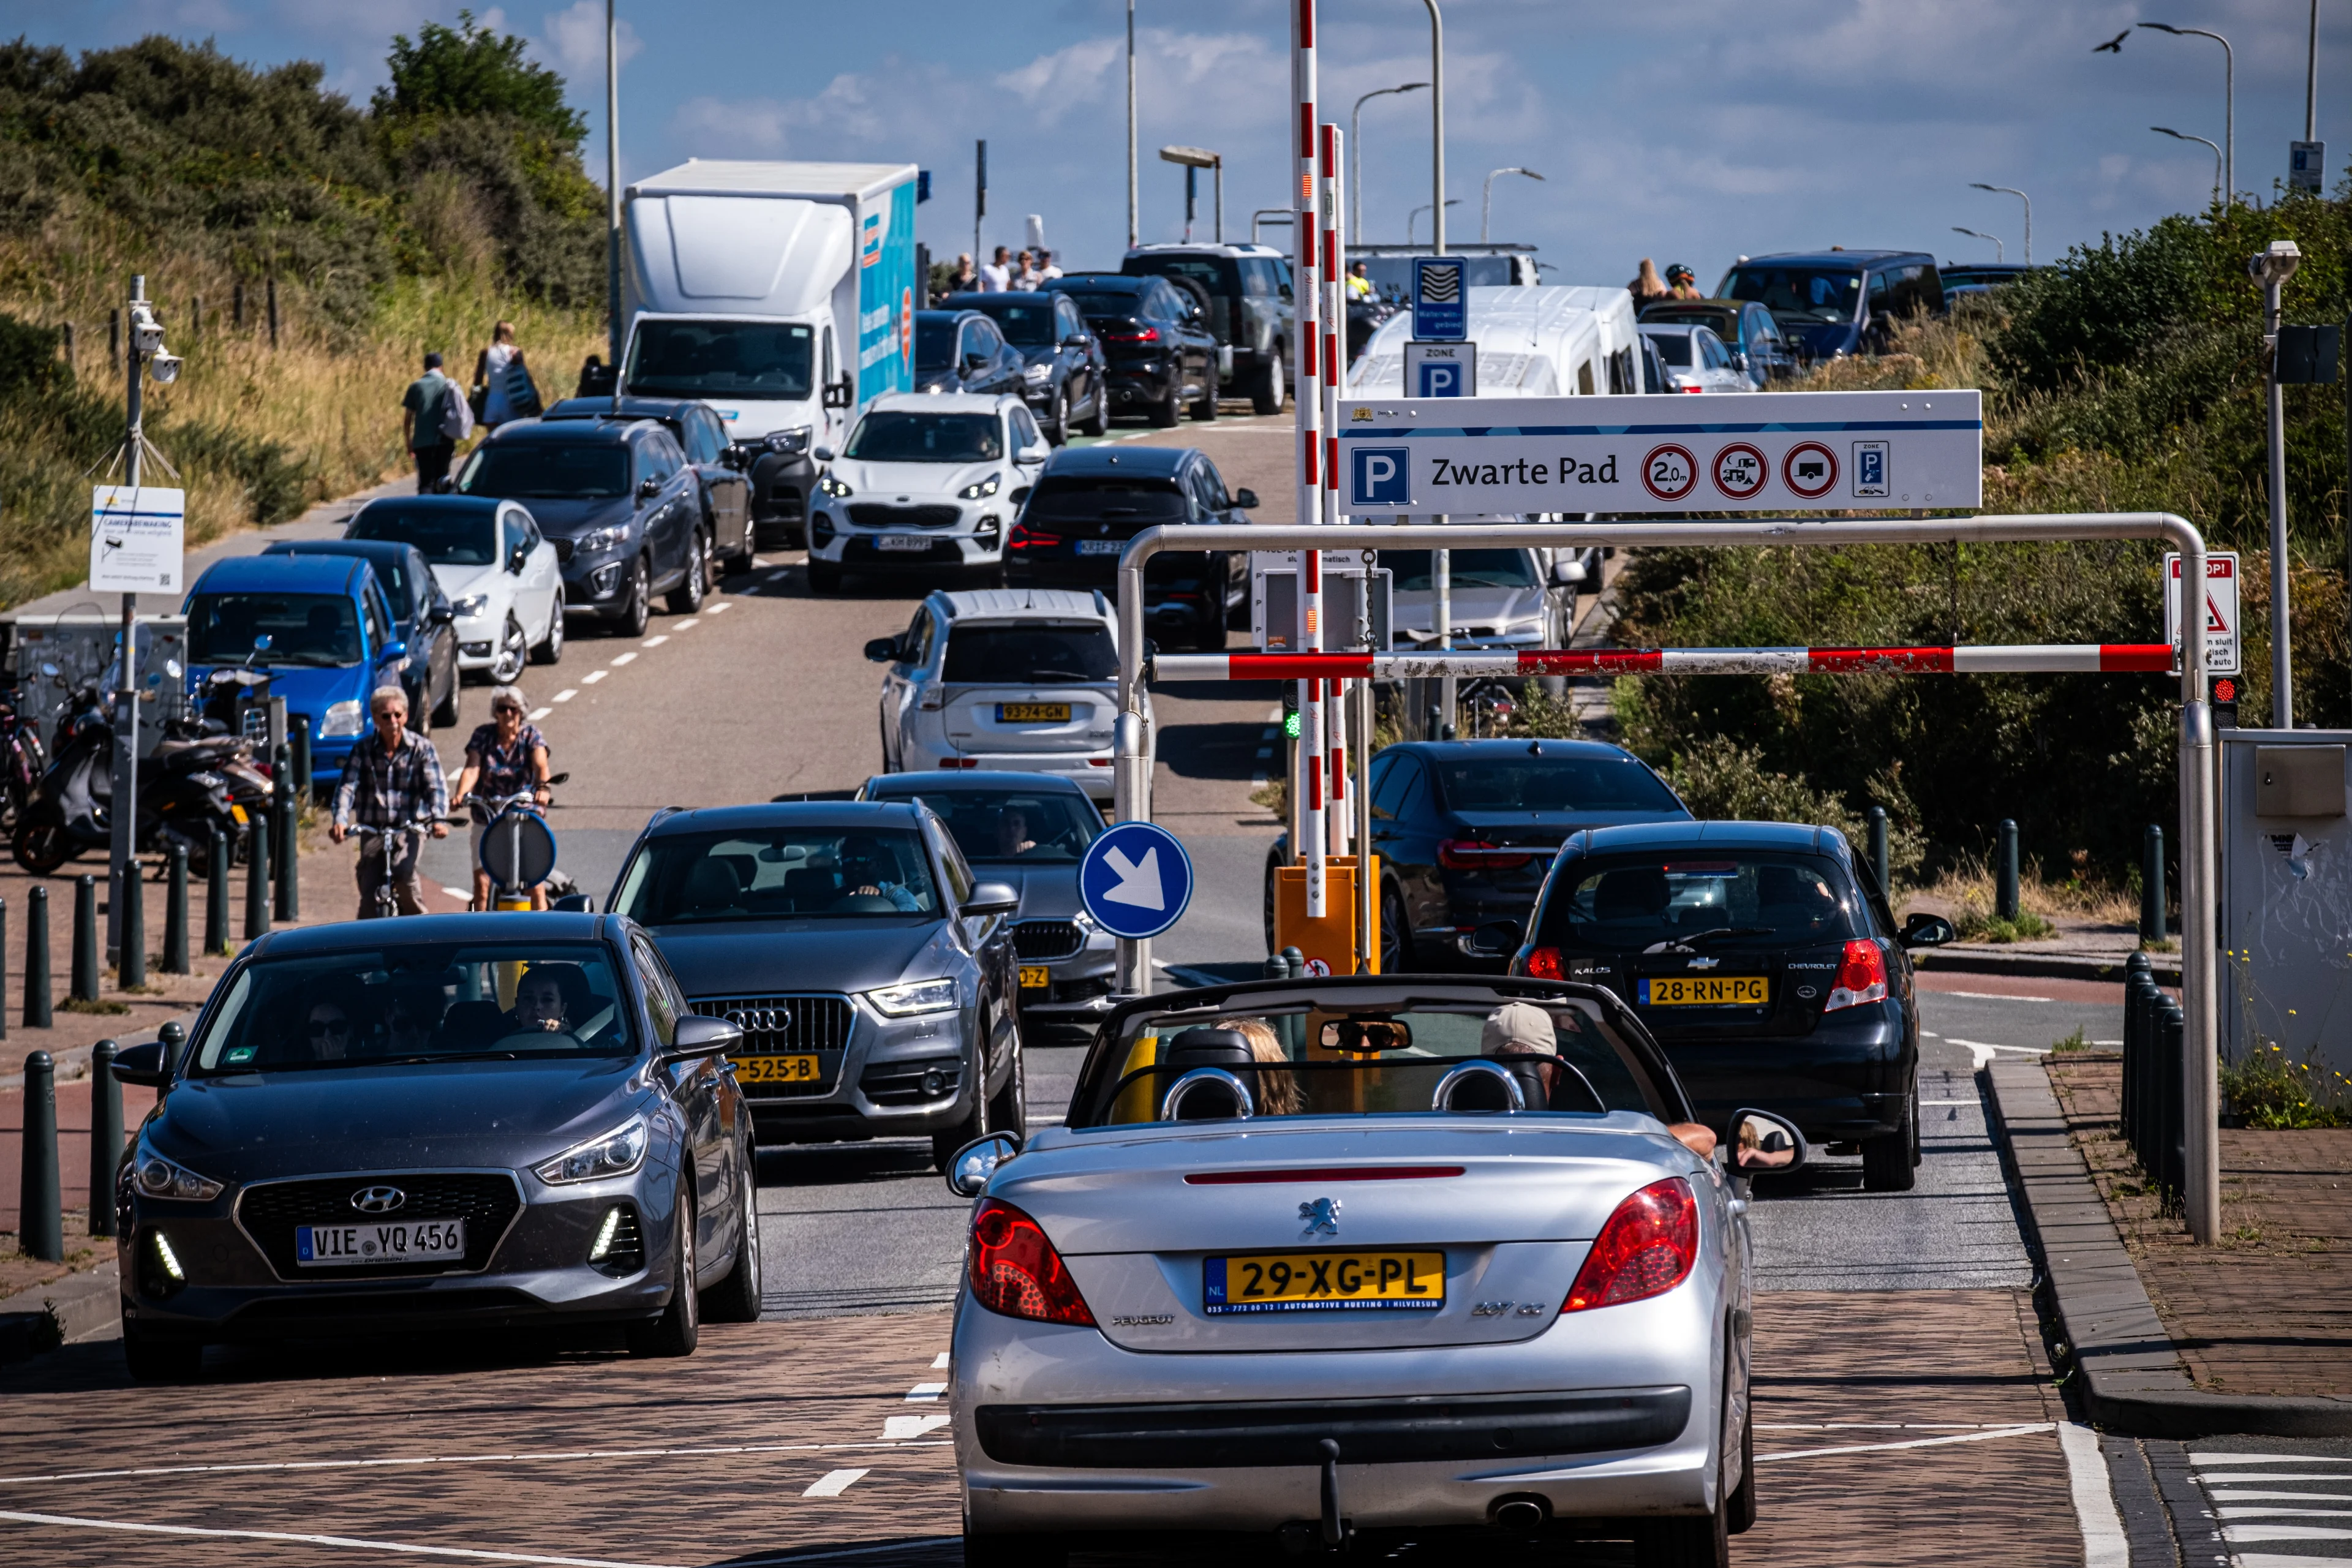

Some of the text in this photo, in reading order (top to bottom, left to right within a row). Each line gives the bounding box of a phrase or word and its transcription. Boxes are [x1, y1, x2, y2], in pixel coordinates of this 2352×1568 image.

[1434, 321, 1463, 330] gebied
[1425, 349, 1455, 358] ZONE
[1432, 454, 1619, 485] Zwarte Pad
[1866, 454, 1878, 470] P
[1366, 455, 1396, 497] P
[1575, 967, 1611, 975] KALOS
[1656, 980, 1762, 1001] 28-RN-PG
[314, 1224, 458, 1256] VIE YQ 456
[1242, 1258, 1428, 1297] 29-XG-PL
[1209, 1287, 1224, 1296] NL
[1471, 1300, 1515, 1316] 207
[1112, 1314, 1175, 1326] PEUGEOT
